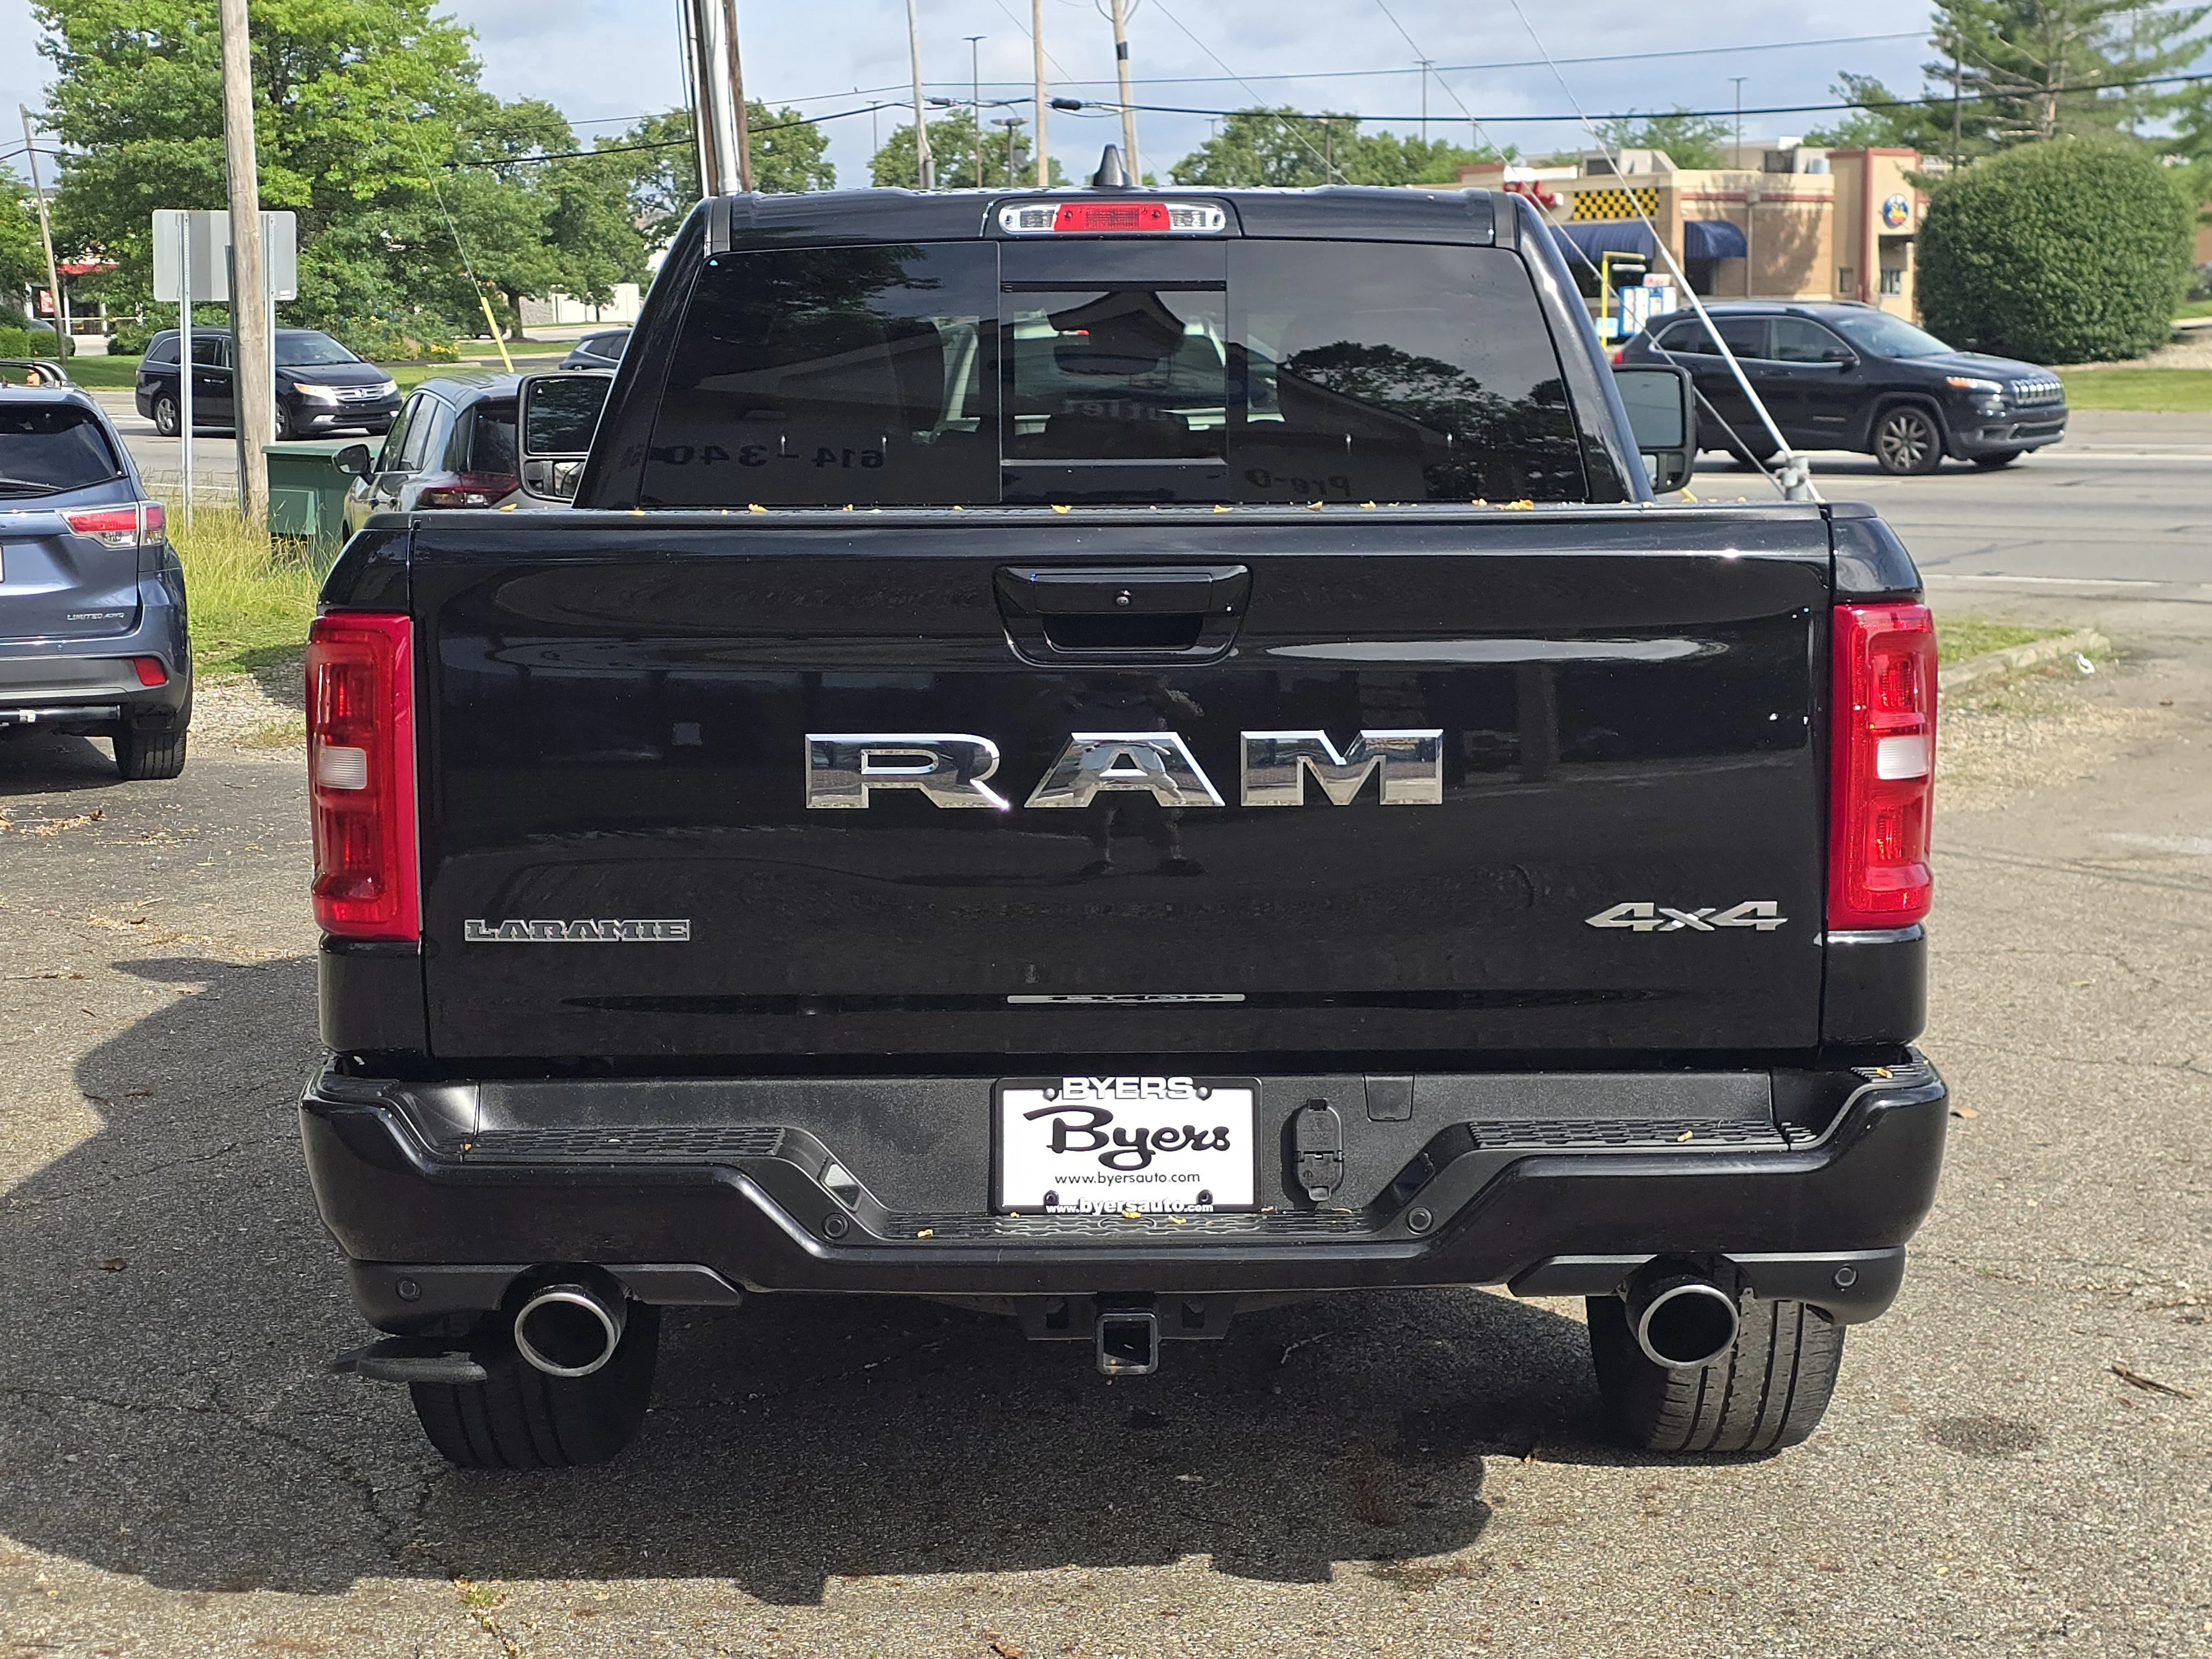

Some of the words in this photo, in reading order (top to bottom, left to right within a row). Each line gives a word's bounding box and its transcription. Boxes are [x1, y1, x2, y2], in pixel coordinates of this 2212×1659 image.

[805, 729, 1443, 809] RAM
[1584, 900, 1788, 931] 4x4
[465, 919, 691, 942] LARAMIE
[1062, 1076, 1194, 1100] BYERS
[1023, 1104, 1231, 1171] Byers
[1054, 1171, 1201, 1187] www.byersauto.com
[1045, 1197, 1214, 1216] www.byersauto.com
